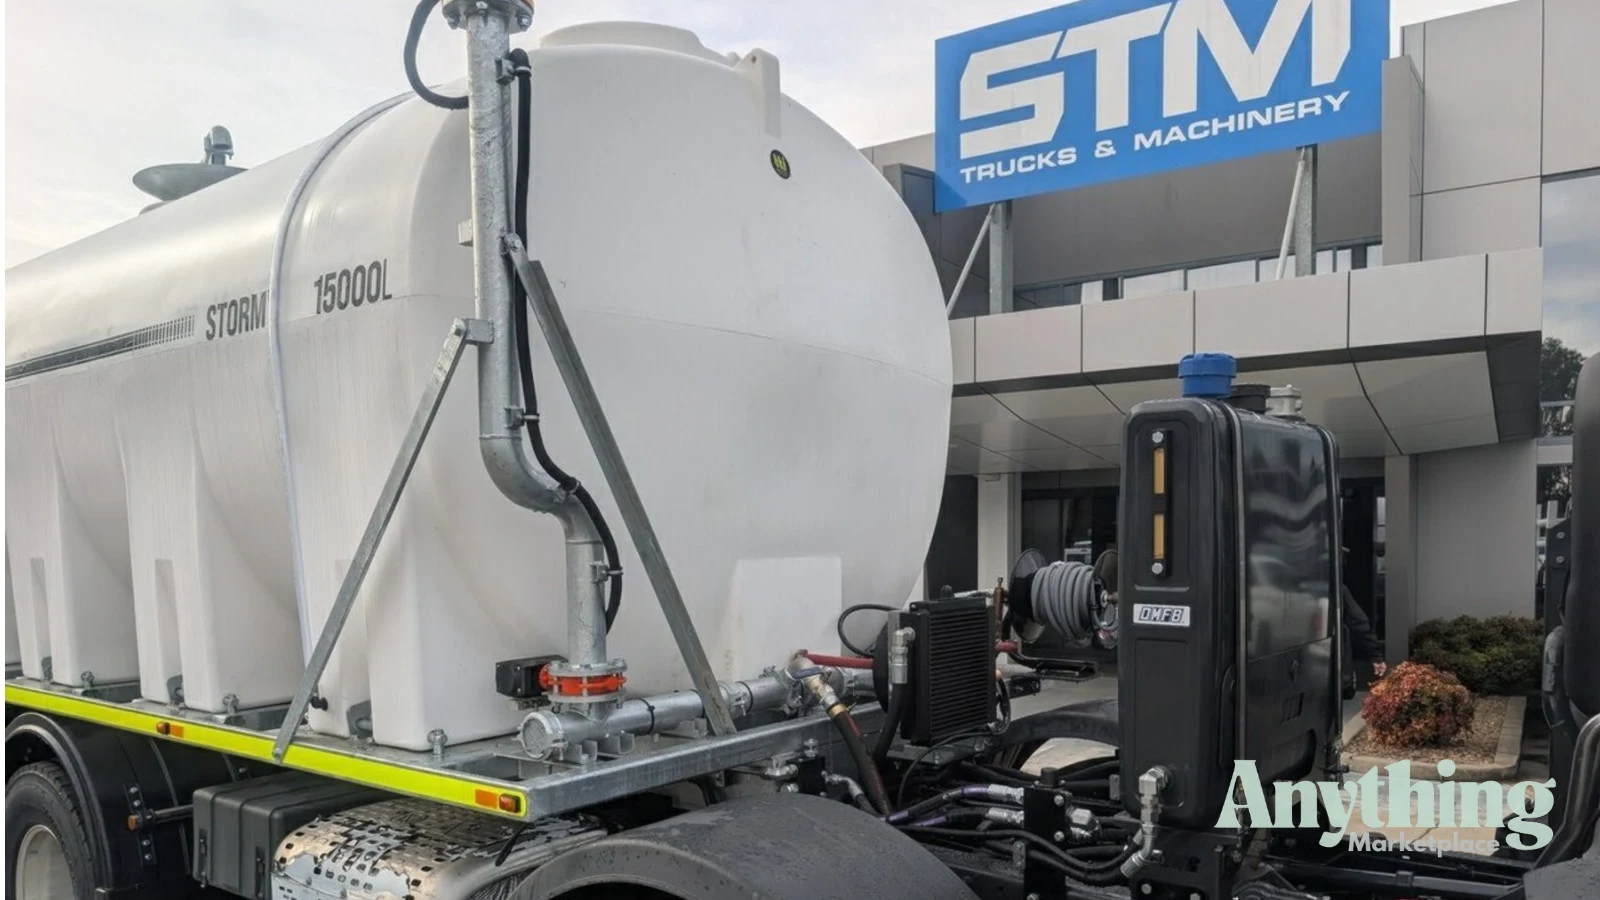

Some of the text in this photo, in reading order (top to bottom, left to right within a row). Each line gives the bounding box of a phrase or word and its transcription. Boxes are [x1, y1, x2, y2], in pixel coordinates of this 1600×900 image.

[960, 0, 1351, 159] STM
[961, 91, 1350, 184] TRUCKS & MACHINERY
[314, 258, 392, 315] 15000L
[1139, 606, 1184, 623] OMFB
